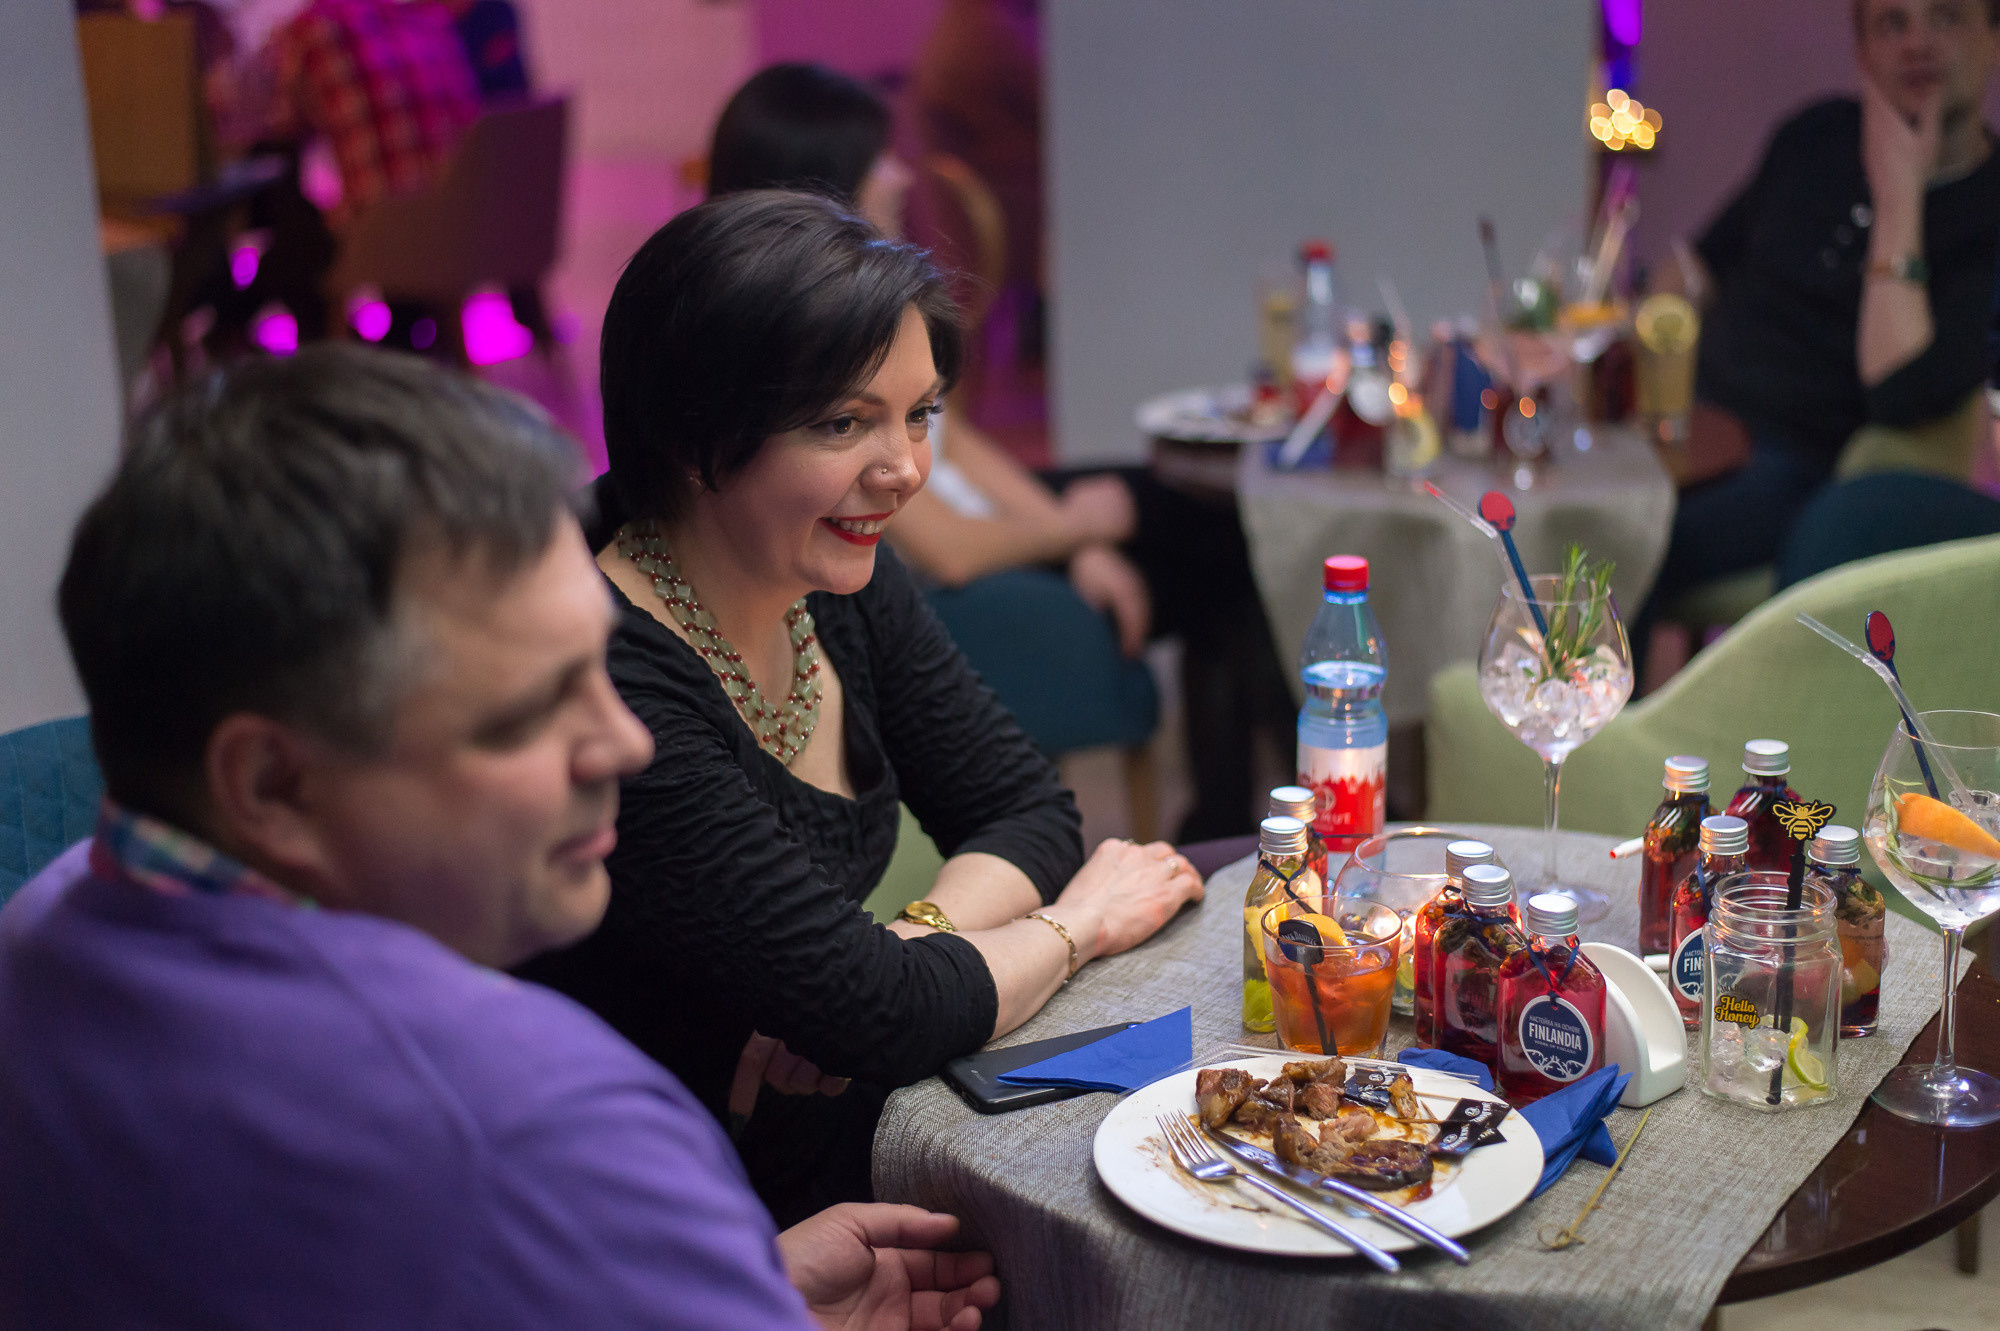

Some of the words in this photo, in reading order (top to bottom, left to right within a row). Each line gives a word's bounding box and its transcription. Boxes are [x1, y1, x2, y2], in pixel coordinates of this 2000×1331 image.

[1683, 956, 1703, 973] FIN
[1715, 1006, 1760, 1028] Honey
[1528, 1022, 1582, 1051] FINLANDIA
